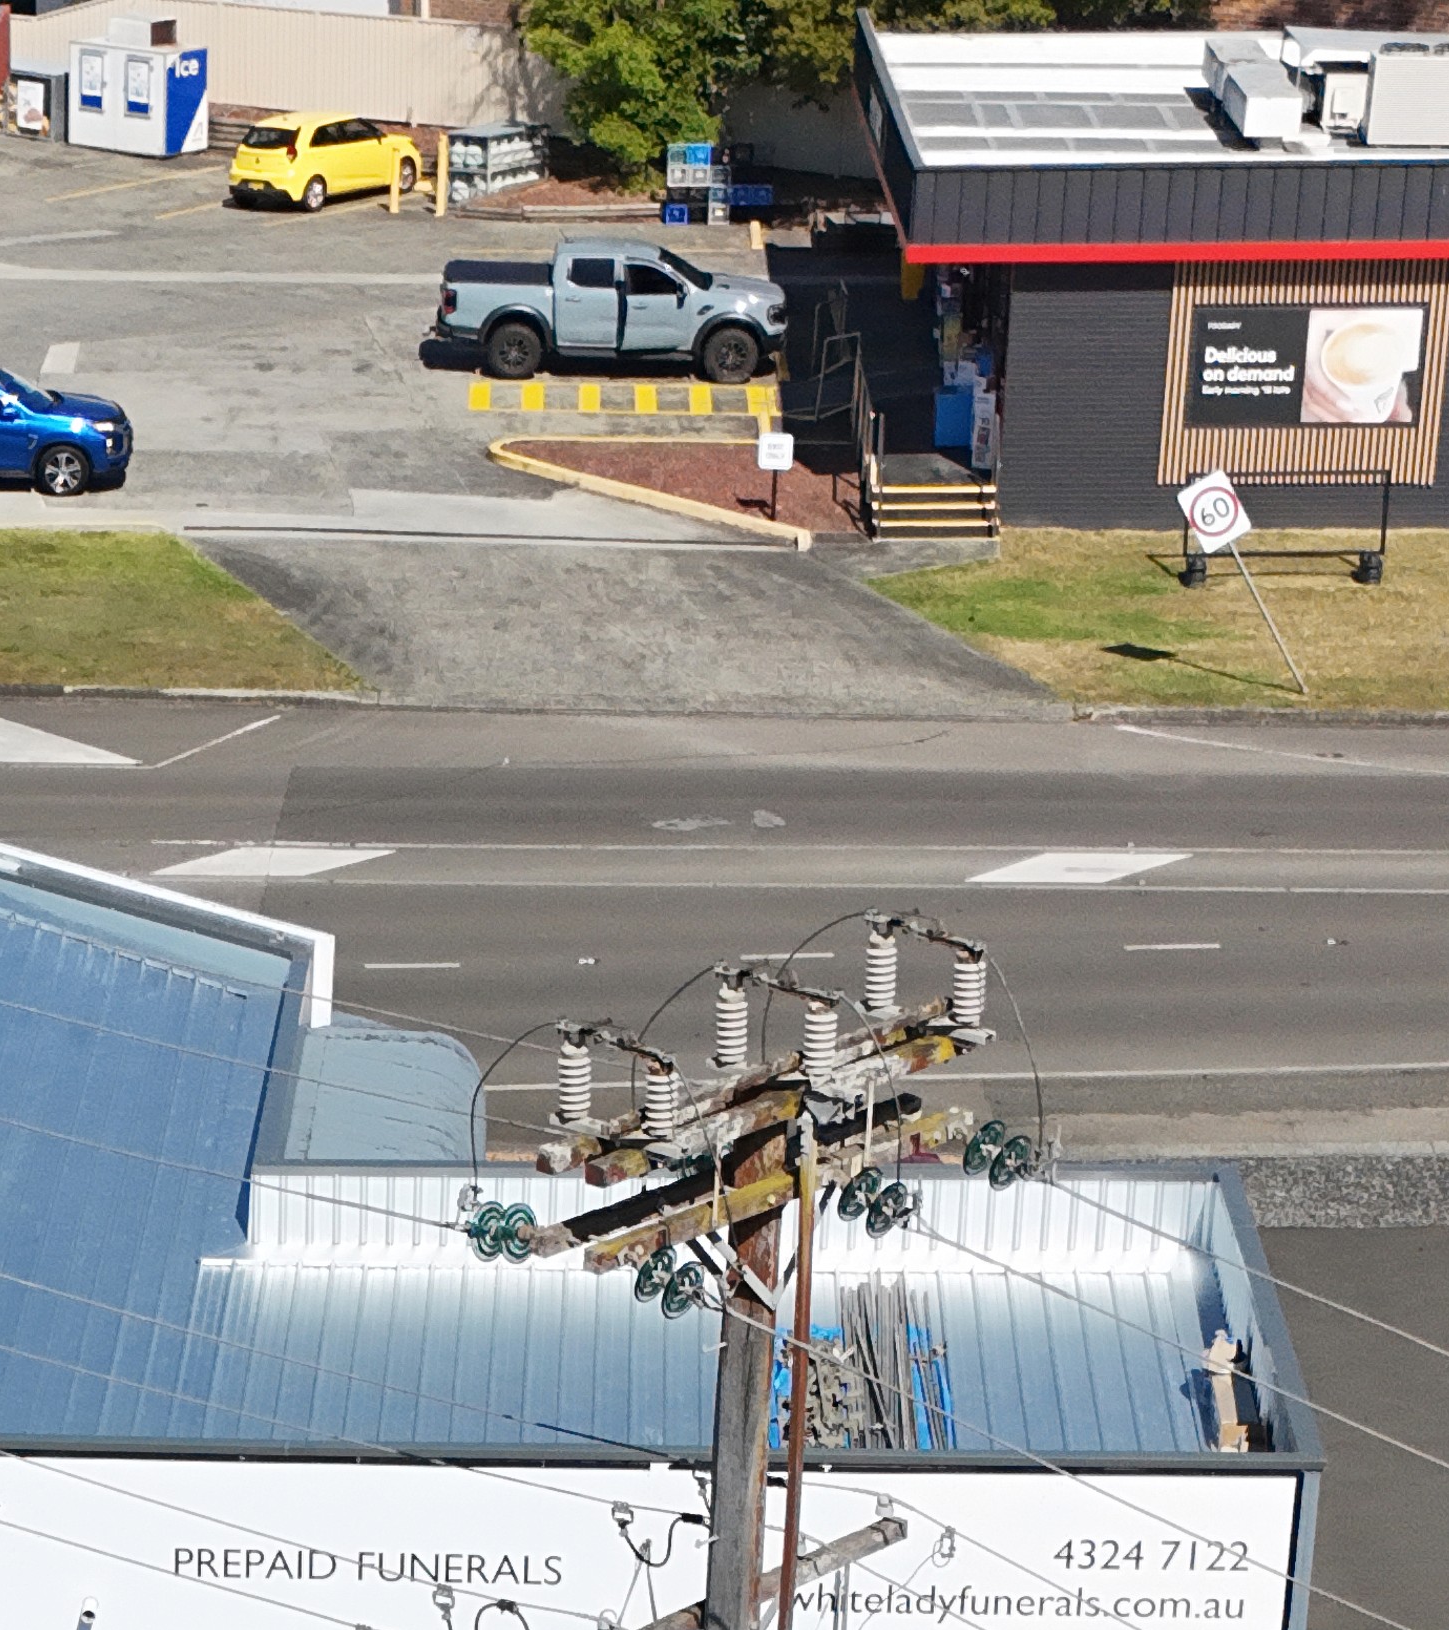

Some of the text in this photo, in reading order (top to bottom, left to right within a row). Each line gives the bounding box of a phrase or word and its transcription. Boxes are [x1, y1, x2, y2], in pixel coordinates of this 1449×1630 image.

[174, 58, 199, 79] Ice
[1204, 346, 1277, 364] Delicious
[1202, 365, 1295, 382] on demand
[1201, 497, 1230, 527] 60
[174, 1547, 564, 1586] PREPAID FUNERALS
[1052, 1539, 1251, 1572] 4324 7122
